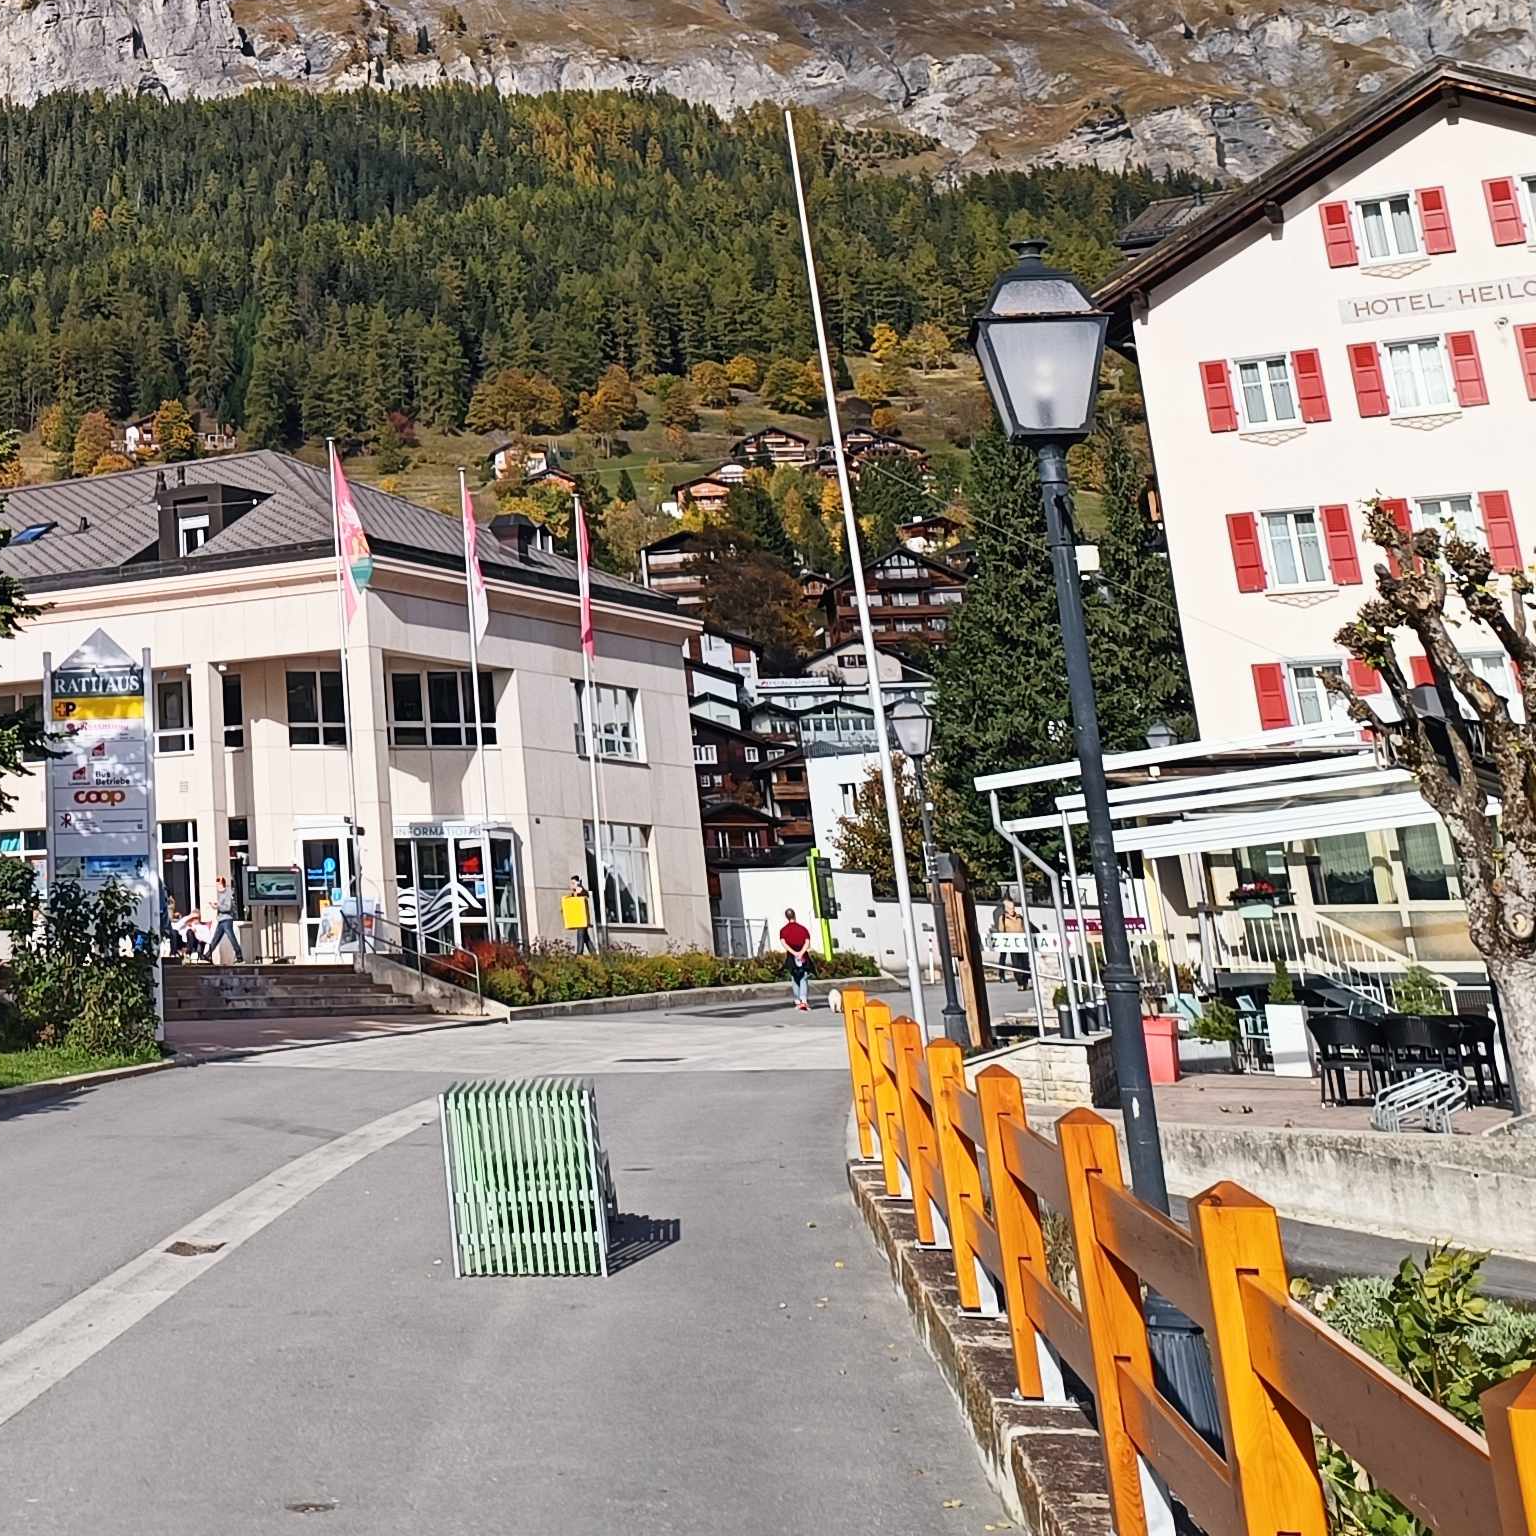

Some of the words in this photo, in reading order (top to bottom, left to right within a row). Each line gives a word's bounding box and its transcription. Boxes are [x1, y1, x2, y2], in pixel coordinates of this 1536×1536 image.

[1353, 293, 1445, 318] HOTEL
[54, 675, 140, 694] RATHAUS
[95, 770, 112, 779] Bus
[95, 777, 131, 786] Betriebe
[73, 789, 126, 807] coop
